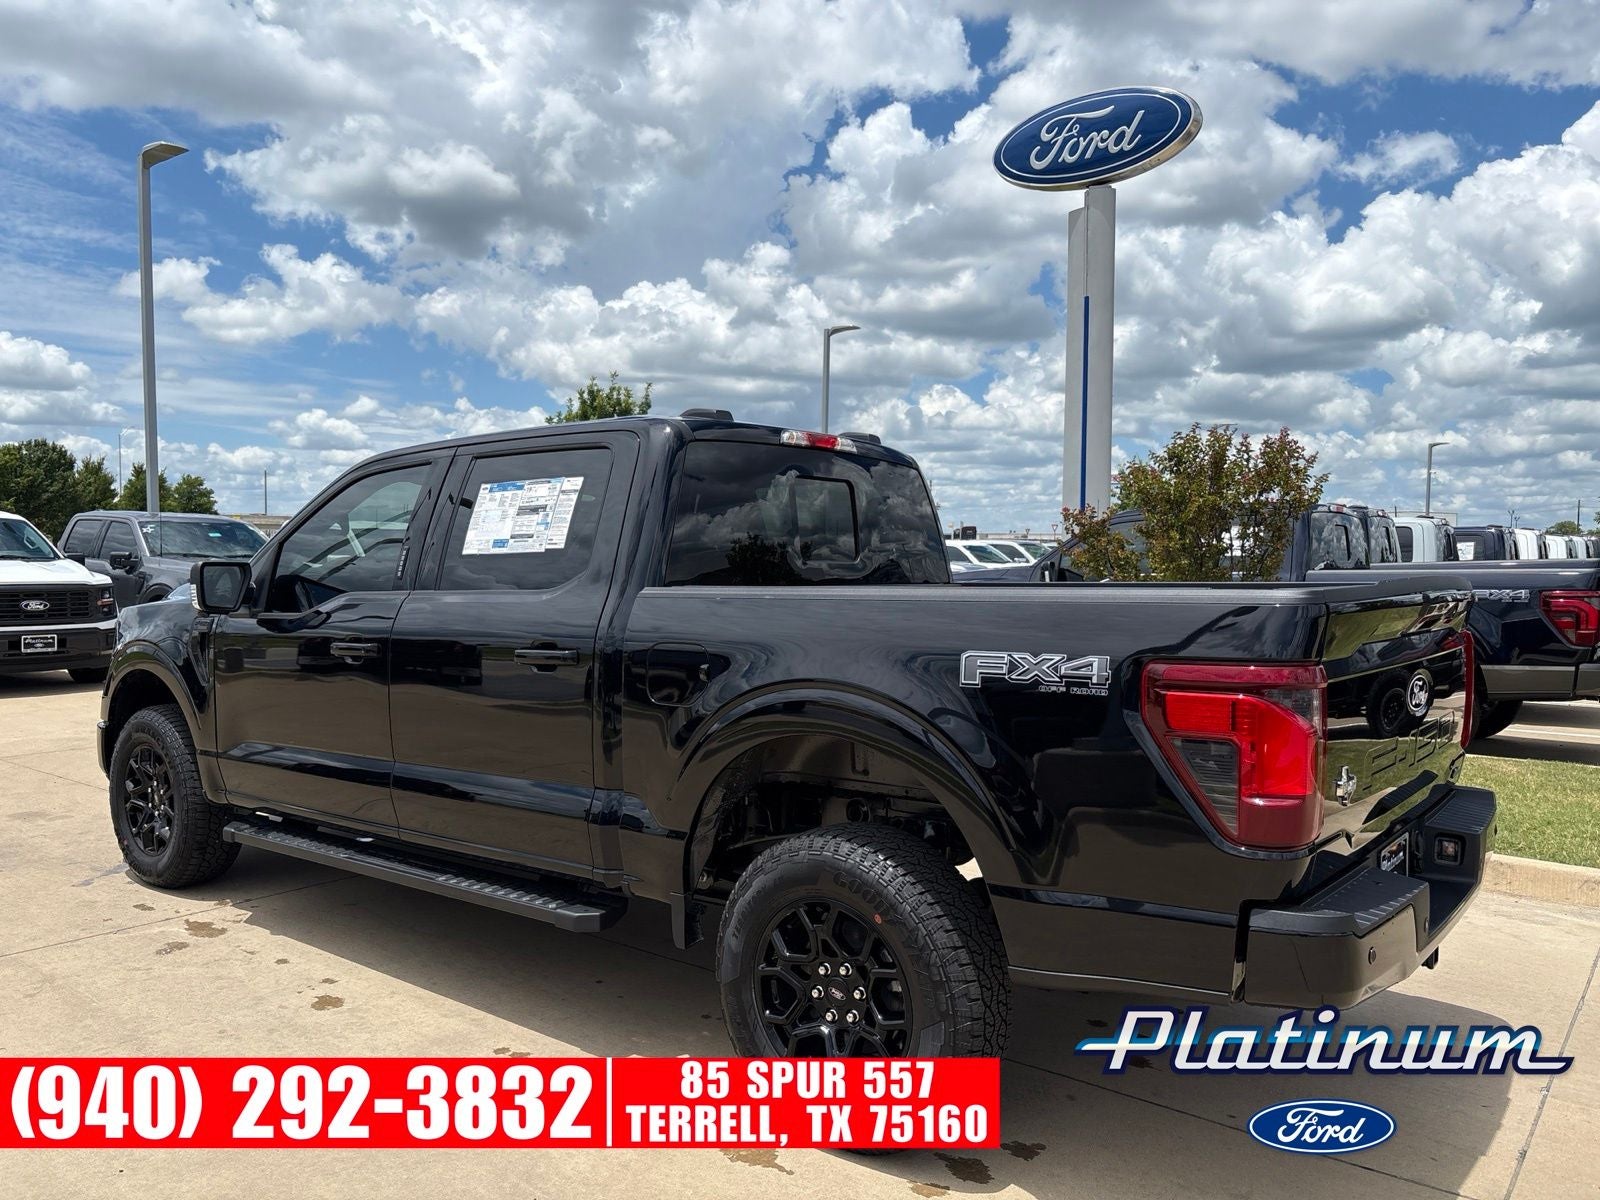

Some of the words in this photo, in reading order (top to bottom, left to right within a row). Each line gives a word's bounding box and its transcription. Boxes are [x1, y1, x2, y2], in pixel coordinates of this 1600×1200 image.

[1029, 105, 1145, 170] Ford
[1471, 589, 1530, 602] FX4
[960, 651, 1111, 688] FX4
[1039, 685, 1066, 693] OFF
[1070, 687, 1108, 696] ROAD
